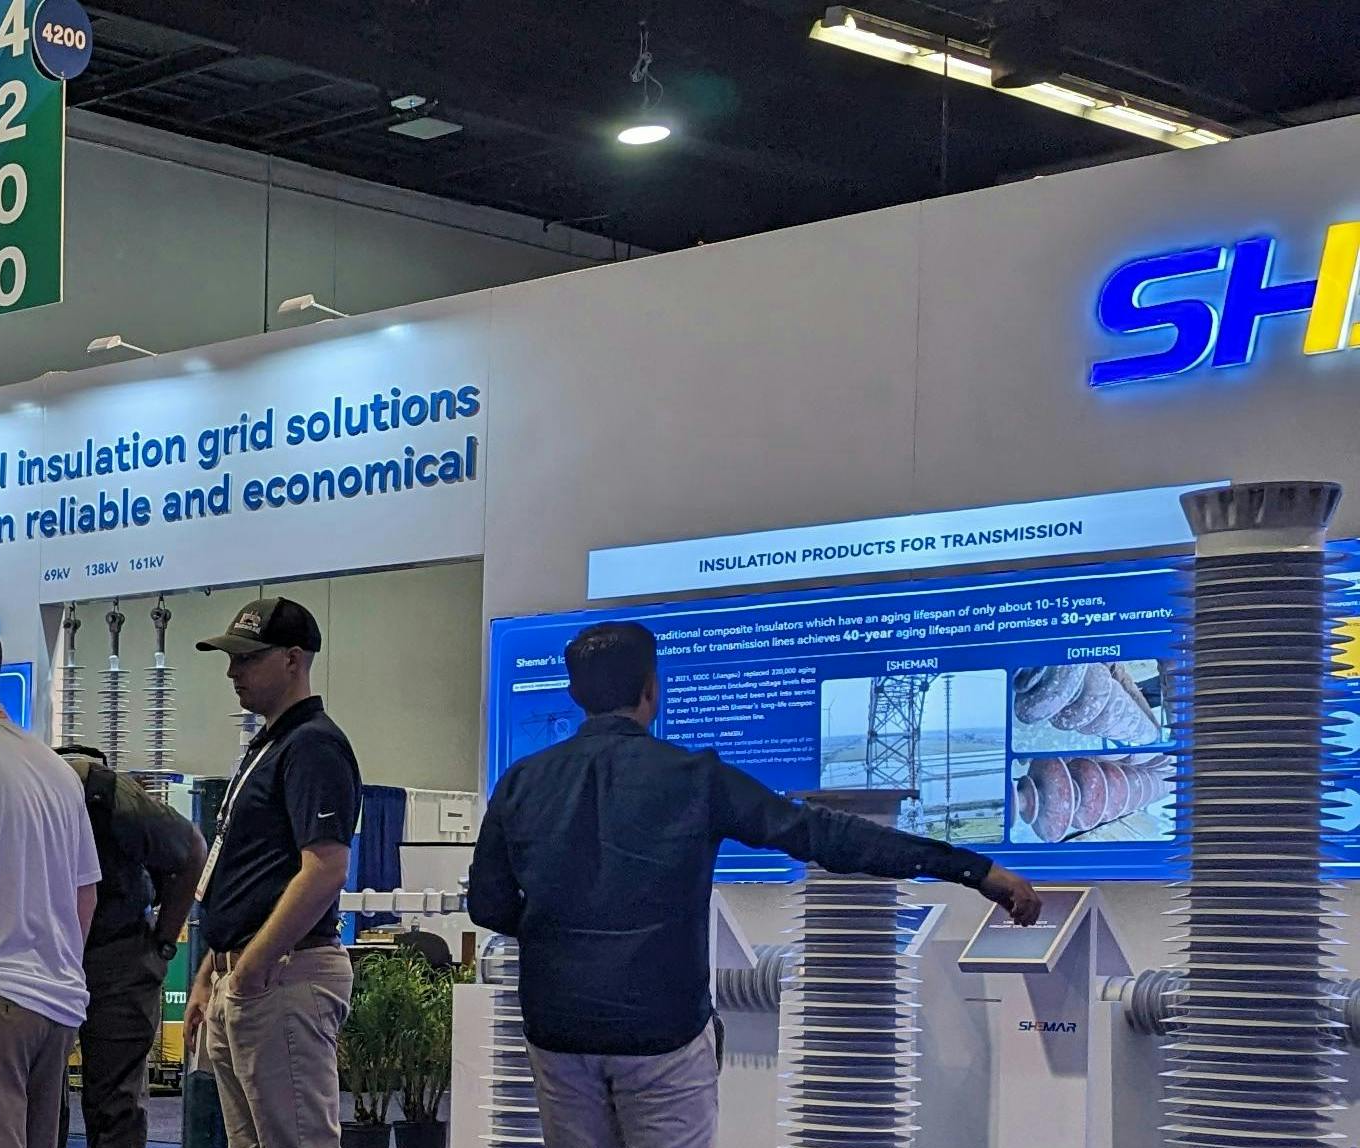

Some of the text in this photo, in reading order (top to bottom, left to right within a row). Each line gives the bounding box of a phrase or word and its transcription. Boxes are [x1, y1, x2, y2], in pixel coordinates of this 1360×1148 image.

[42, 22, 86, 50] 4200
[18, 433, 185, 485] insulation
[197, 408, 273, 470] grid
[286, 385, 480, 446] solutions
[25, 487, 151, 538] reliable
[162, 473, 231, 522] and
[243, 435, 478, 512] economical
[698, 521, 1083, 573] INSULATION PRODUCTS FOR TRANSMISSION
[44, 555, 164, 582] 69kV 138kV 161kV
[693, 643, 707, 654] for
[709, 640, 770, 652] transmission
[772, 636, 794, 647] lines
[797, 633, 840, 645] achieves
[843, 628, 894, 645] 40-year
[896, 626, 926, 639] aging
[929, 623, 971, 637] lifespan
[974, 620, 995, 632] and
[998, 617, 1048, 631] promises
[1051, 618, 1058, 626] a
[1061, 611, 1116, 628] 30-year
[1119, 607, 1174, 622] warranty.
[703, 625, 753, 638] composite
[755, 620, 804, 633] insulators
[806, 617, 836, 629] which
[838, 615, 863, 626] have
[865, 614, 878, 624] an
[881, 611, 911, 625] aging
[913, 609, 955, 621] lifespan
[958, 606, 970, 616] of
[972, 604, 995, 616] only
[999, 601, 1032, 612] about
[1035, 597, 1069, 609] 10-15
[1071, 595, 1106, 609] years,
[886, 657, 938, 671] [SHEMAR]
[1067, 645, 1120, 659] [OTHERS]
[1018, 1020, 1077, 1033] SHEMAR
